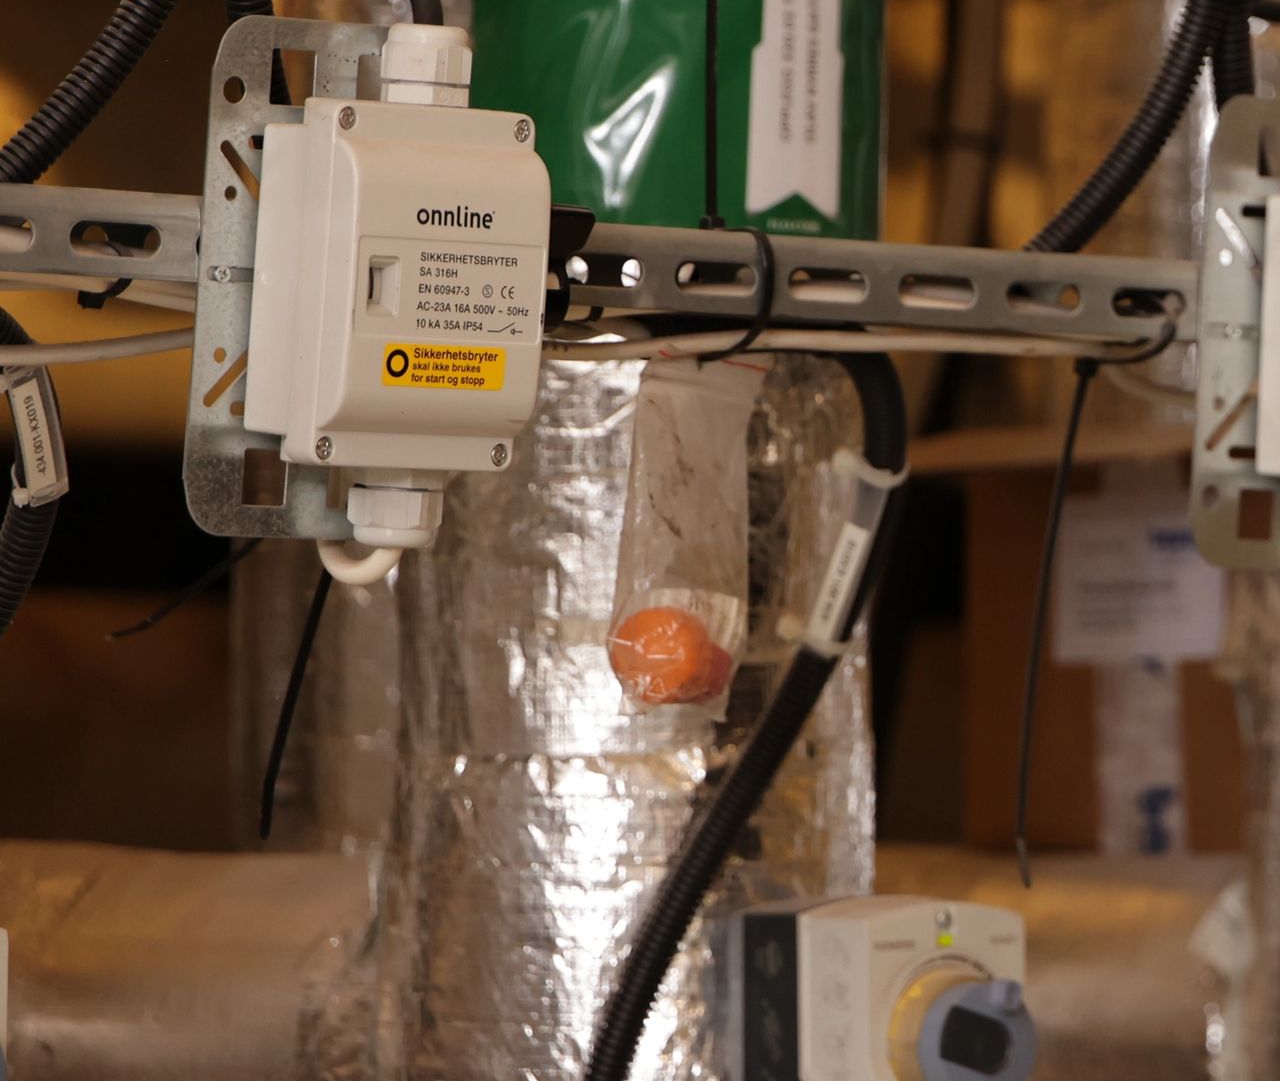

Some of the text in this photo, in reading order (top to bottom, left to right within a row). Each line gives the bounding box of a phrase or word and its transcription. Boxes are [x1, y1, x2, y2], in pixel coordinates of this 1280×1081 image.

[417, 205, 494, 229] onnline
[420, 252, 518, 267] SIKKERHETSBRYTER
[419, 267, 458, 278] SA 316H
[418, 284, 431, 294] EN
[434, 284, 470, 296] 60947-3
[416, 302, 451, 312] AC-23A
[454, 303, 470, 314] 16A
[473, 304, 496, 315] 500V
[507, 306, 529, 317] 50Hz
[416, 318, 483, 331] 10 kA 35A IP54
[413, 348, 498, 362] Sikkerhetsbryter
[413, 362, 481, 373] skal ikke brukes
[411, 373, 485, 387] for start og stopp
